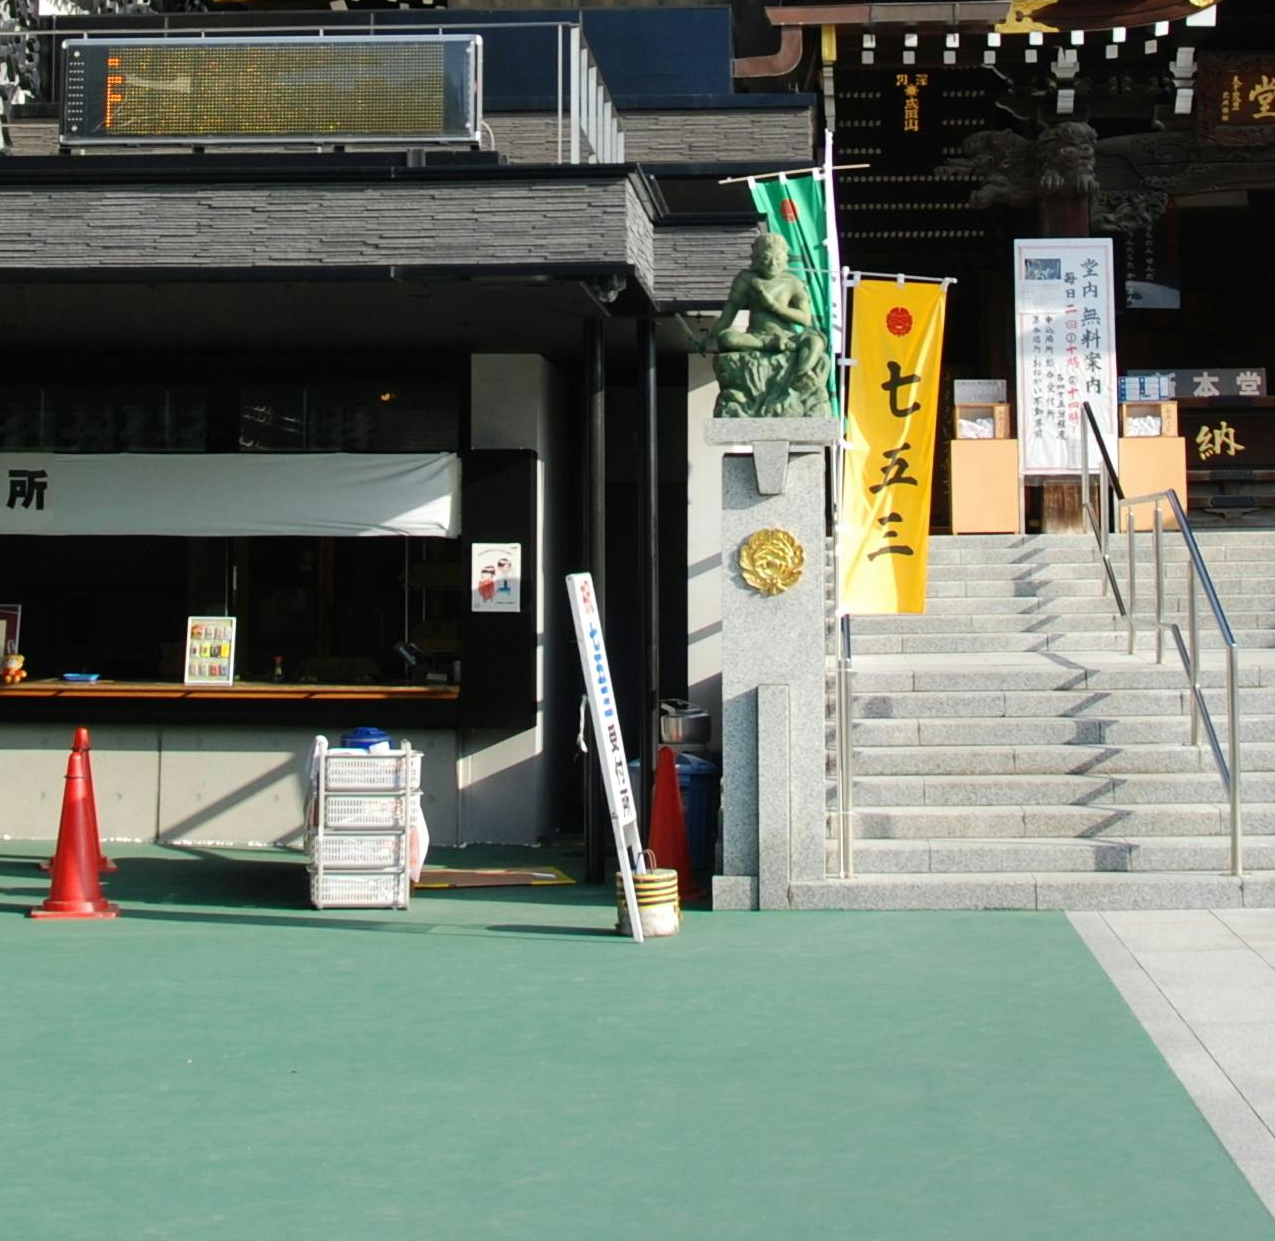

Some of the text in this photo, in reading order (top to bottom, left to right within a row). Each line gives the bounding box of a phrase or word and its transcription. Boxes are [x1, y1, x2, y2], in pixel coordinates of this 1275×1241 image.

[867, 361, 922, 561] 七五三
[1196, 420, 1245, 461] 納
